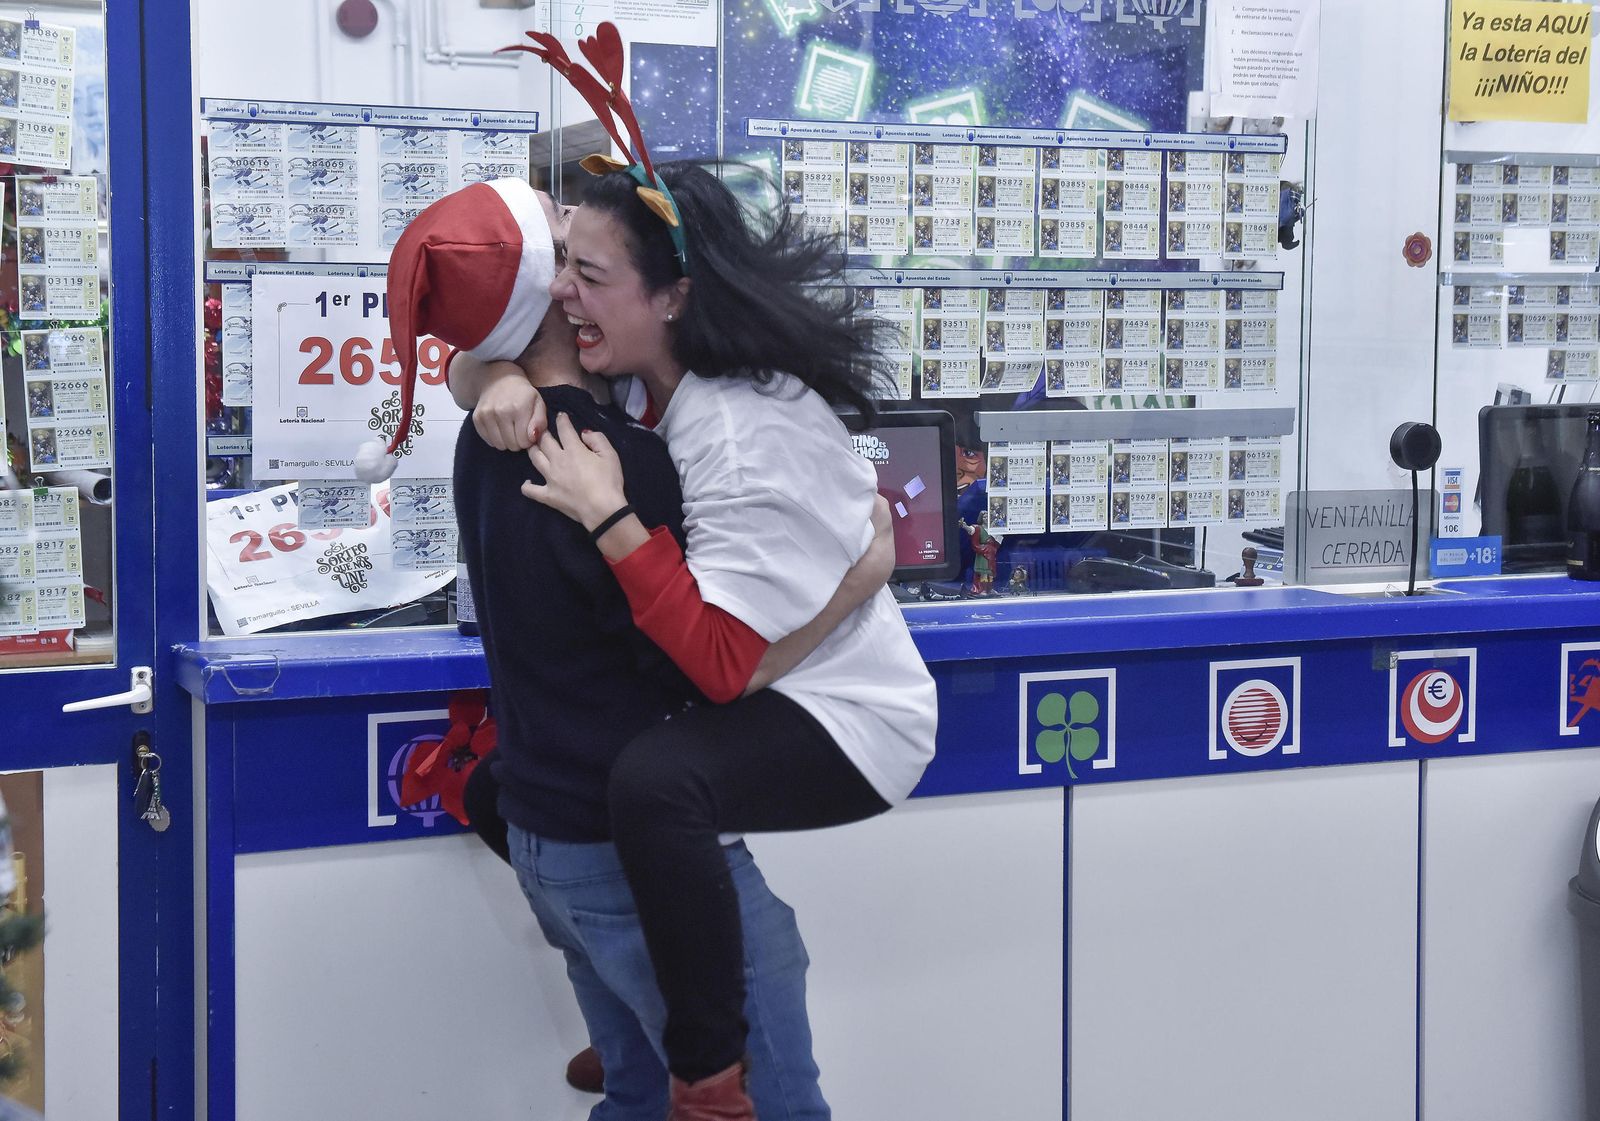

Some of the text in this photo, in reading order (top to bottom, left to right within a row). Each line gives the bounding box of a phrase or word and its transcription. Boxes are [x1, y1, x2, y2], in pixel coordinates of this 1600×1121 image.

[1462, 12, 1590, 35] Ya esta AQUÍ
[1460, 42, 1587, 65] la Lotería del
[21, 74, 57, 86] 31086
[1475, 71, 1568, 97] ¡¡¡NIÑO!!!
[18, 122, 54, 133] 31086
[46, 229, 82, 238] 03119
[316, 291, 350, 318] 1er
[54, 382, 89, 390] 22666
[57, 428, 92, 437] 22666
[280, 460, 319, 469] Tamarguillo
[324, 489, 355, 497] 67627
[229, 502, 261, 520] 1er
[37, 540, 65, 549] 8917
[1322, 540, 1404, 564] CERRADA
[1470, 547, 1492, 564] +18
[333, 556, 372, 574] QUE NOS
[331, 570, 367, 592] UNE
[39, 587, 67, 596] 8917
[248, 600, 320, 622] Tamarguillo SEVILLA
